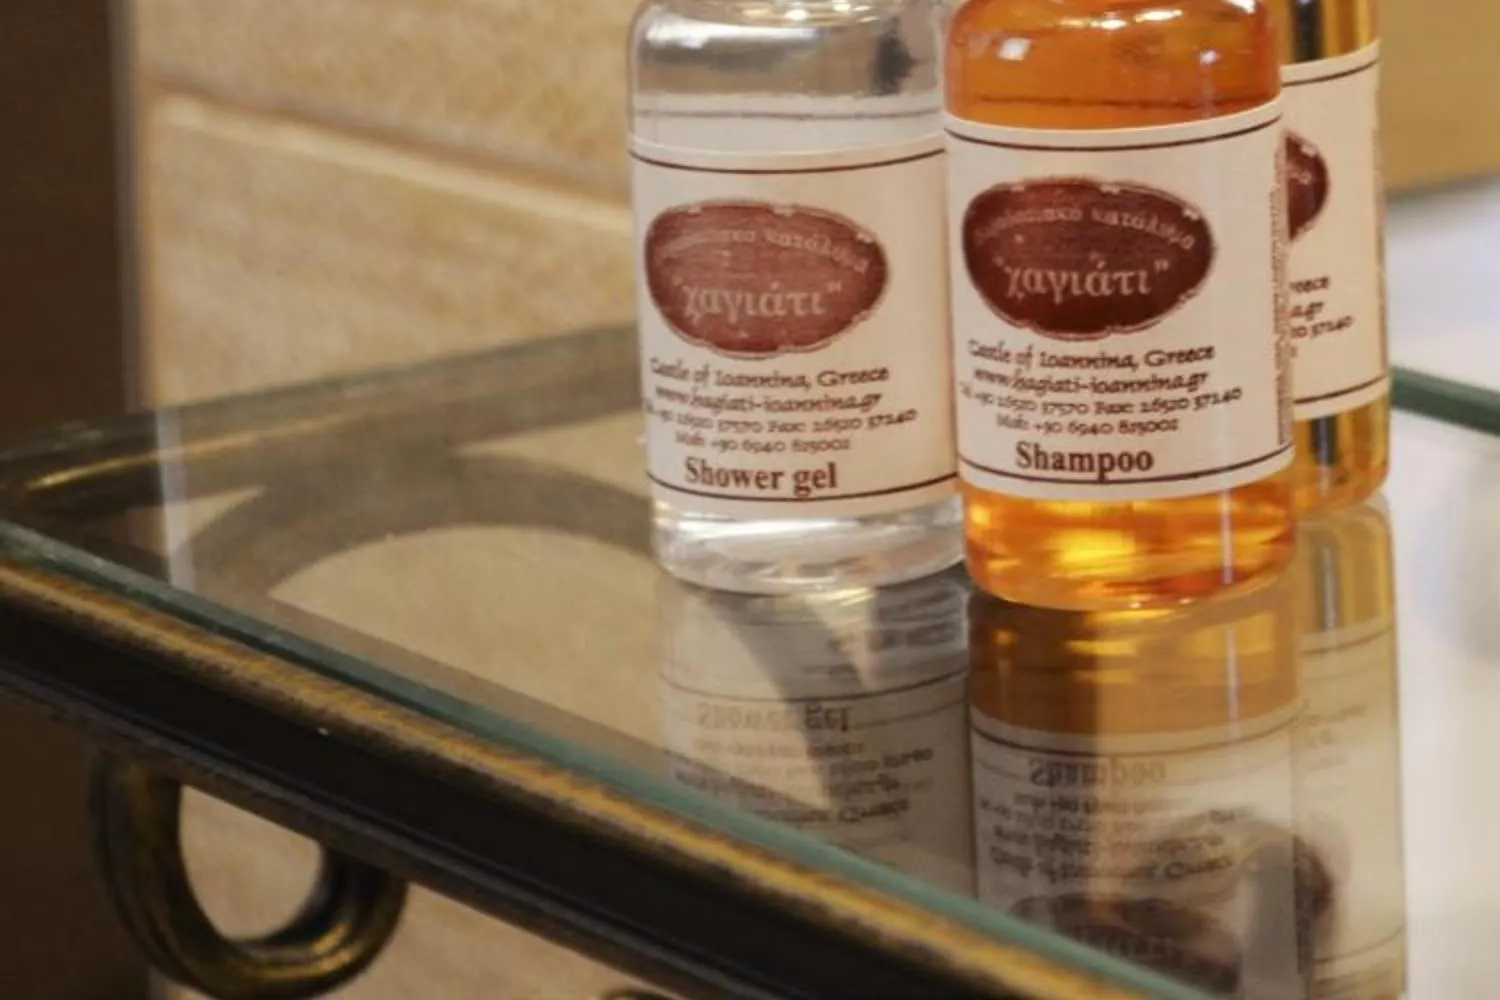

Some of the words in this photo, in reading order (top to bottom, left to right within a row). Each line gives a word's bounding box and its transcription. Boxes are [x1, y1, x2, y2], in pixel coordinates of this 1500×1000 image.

[650, 356, 690, 381] Castle
[694, 362, 711, 388] of
[715, 369, 812, 390] Ioannina,
[817, 367, 889, 387] Greece
[967, 338, 1011, 364] Castle
[1015, 344, 1034, 368] of
[1040, 351, 1139, 371] Ioannina,
[1144, 345, 1215, 367] Greece
[684, 455, 784, 491] Shower
[793, 462, 838, 498] gel
[1016, 441, 1154, 482] Shampoo
